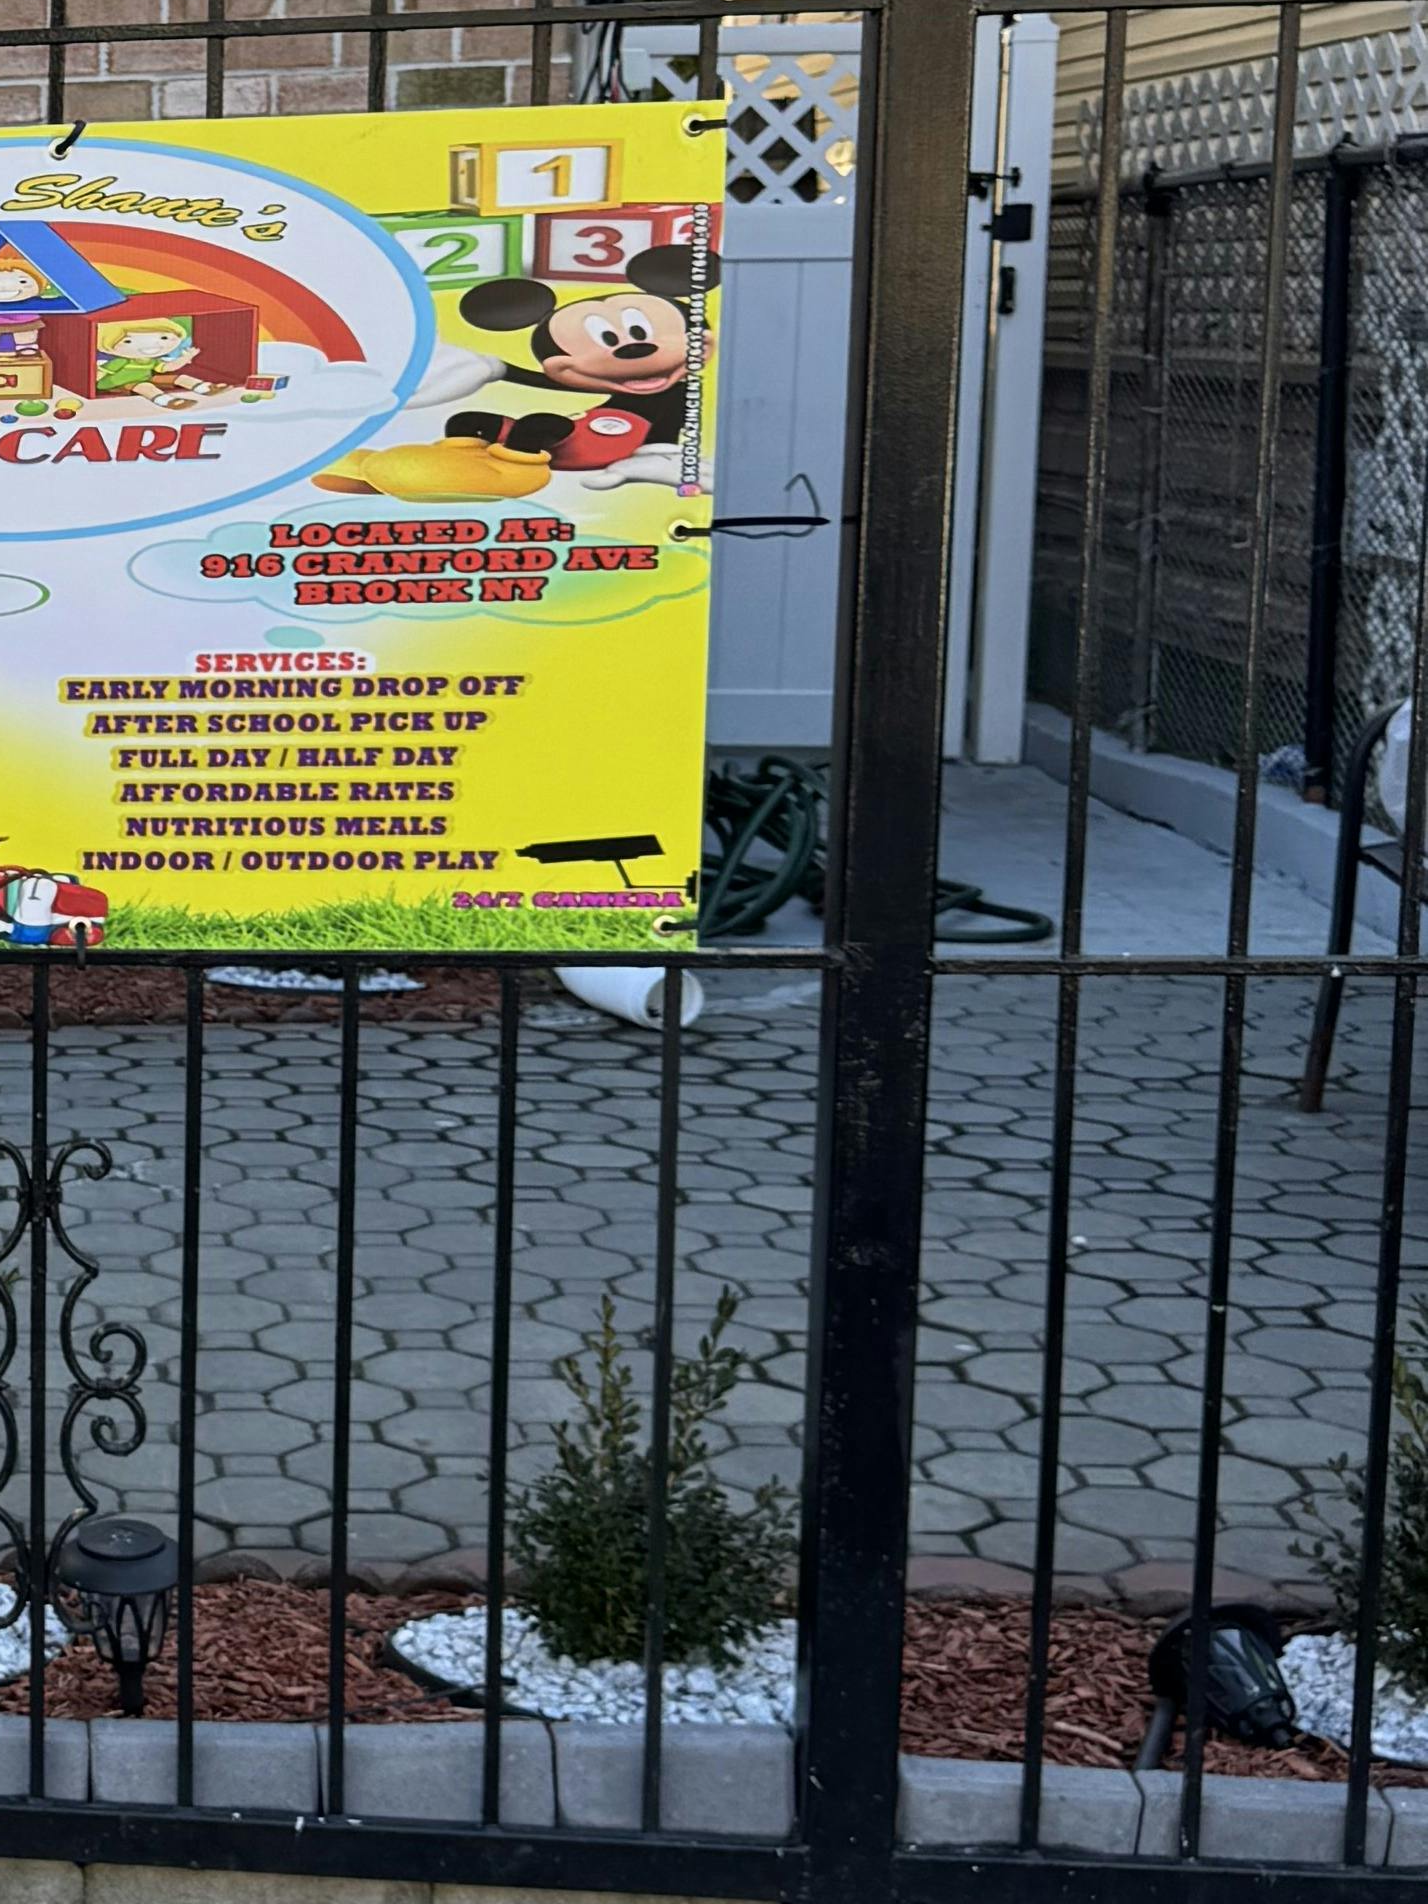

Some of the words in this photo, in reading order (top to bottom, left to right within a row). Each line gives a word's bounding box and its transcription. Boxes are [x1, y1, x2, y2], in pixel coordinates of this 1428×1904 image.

[0, 173, 288, 242] Shante's
[270, 520, 488, 549] LOCATED
[496, 518, 575, 544] AT:
[201, 553, 285, 579] 916
[293, 547, 557, 576] CRANFORD
[563, 546, 659, 571] AVE
[295, 579, 474, 605] BRONX
[479, 578, 549, 602] NY
[195, 652, 367, 673] SERVICES:
[66, 680, 170, 700] EARLY
[179, 678, 342, 699] MORNING
[352, 677, 448, 698] DROP
[459, 675, 524, 696] OFF
[91, 714, 199, 735] AFTER
[207, 713, 341, 734] SCHOOL
[350, 712, 435, 732] PICK
[444, 710, 488, 731] UP
[118, 748, 198, 768] FULL
[207, 748, 273, 768] DAY
[280, 747, 289, 768] /
[297, 747, 383, 767] HALF
[392, 746, 459, 766] DAY
[120, 782, 340, 803] AFFORDABLE
[348, 781, 455, 802] RATES
[126, 817, 325, 837] NUTRITIOUS
[335, 816, 448, 836] MEALS
[82, 851, 215, 871] INDOOR
[223, 851, 232, 871] /
[241, 851, 405, 871] OUTDOOR
[413, 851, 499, 871] PLAY
[451, 892, 525, 909] 24/7
[531, 892, 685, 909] CAMERA
